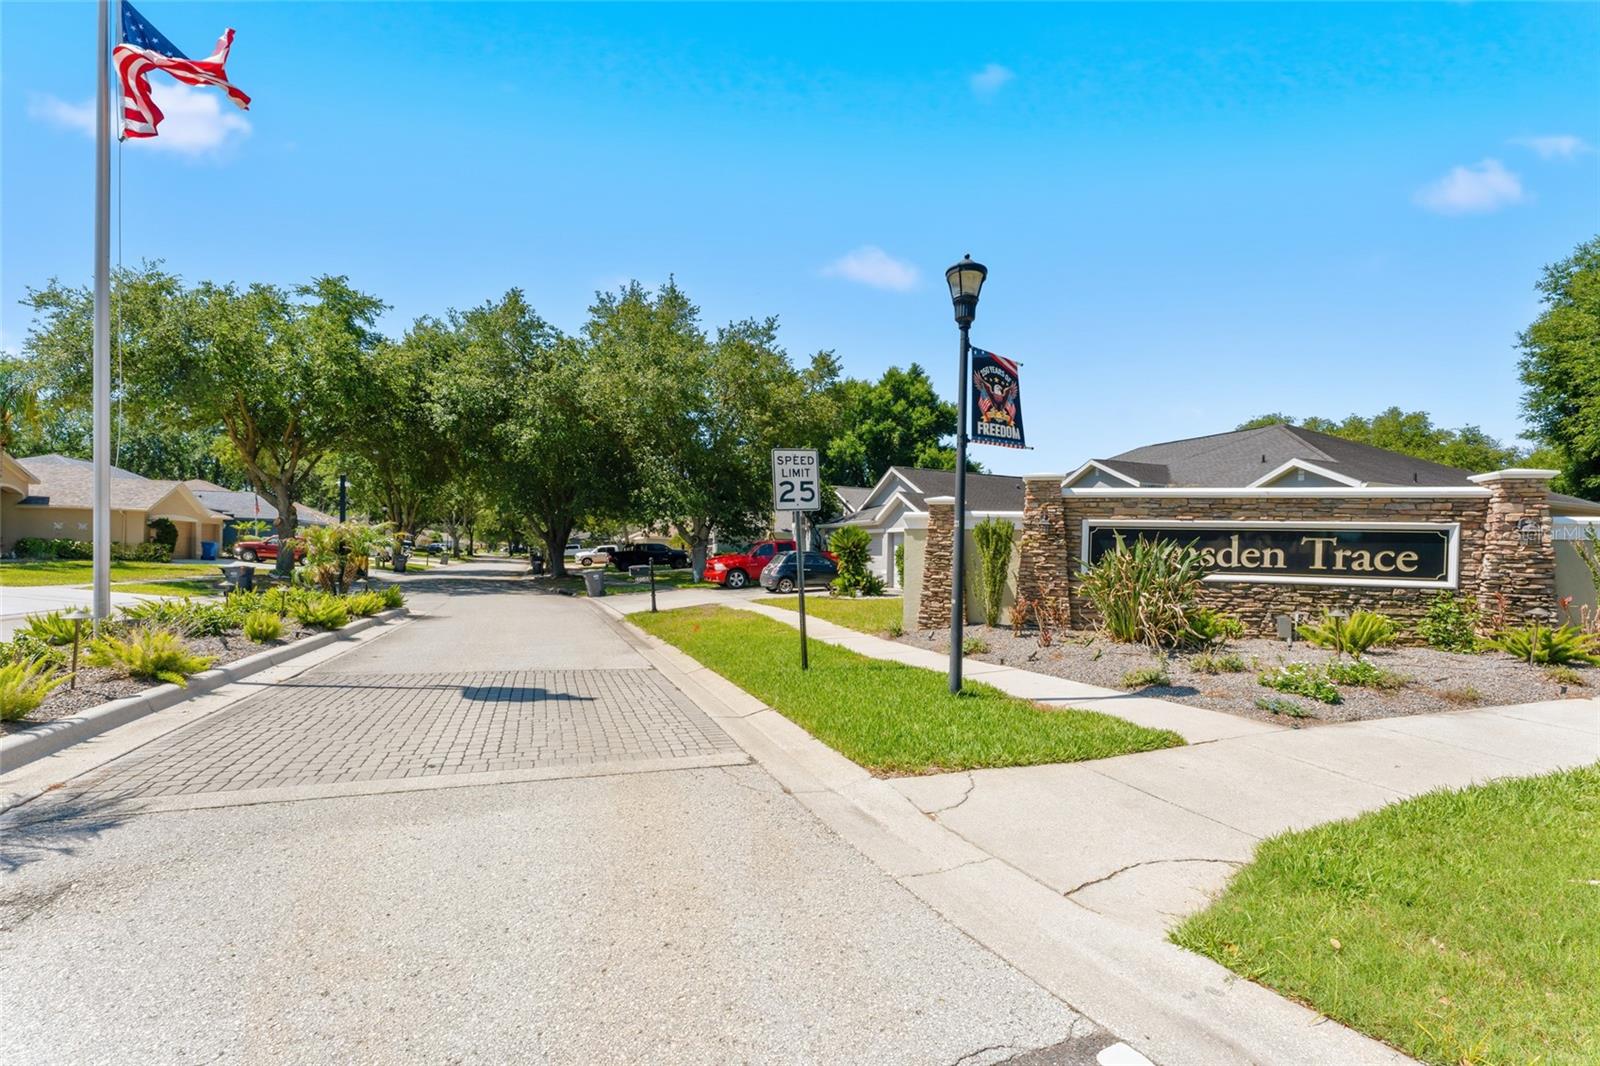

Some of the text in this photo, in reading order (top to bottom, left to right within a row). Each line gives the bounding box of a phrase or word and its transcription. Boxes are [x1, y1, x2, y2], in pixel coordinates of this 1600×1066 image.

[977, 421, 1021, 440] FREEDOM
[777, 456, 815, 465] SPEED
[781, 468, 810, 478] LIMIT
[779, 480, 815, 502] 25
[1300, 535, 1420, 573] Trace
